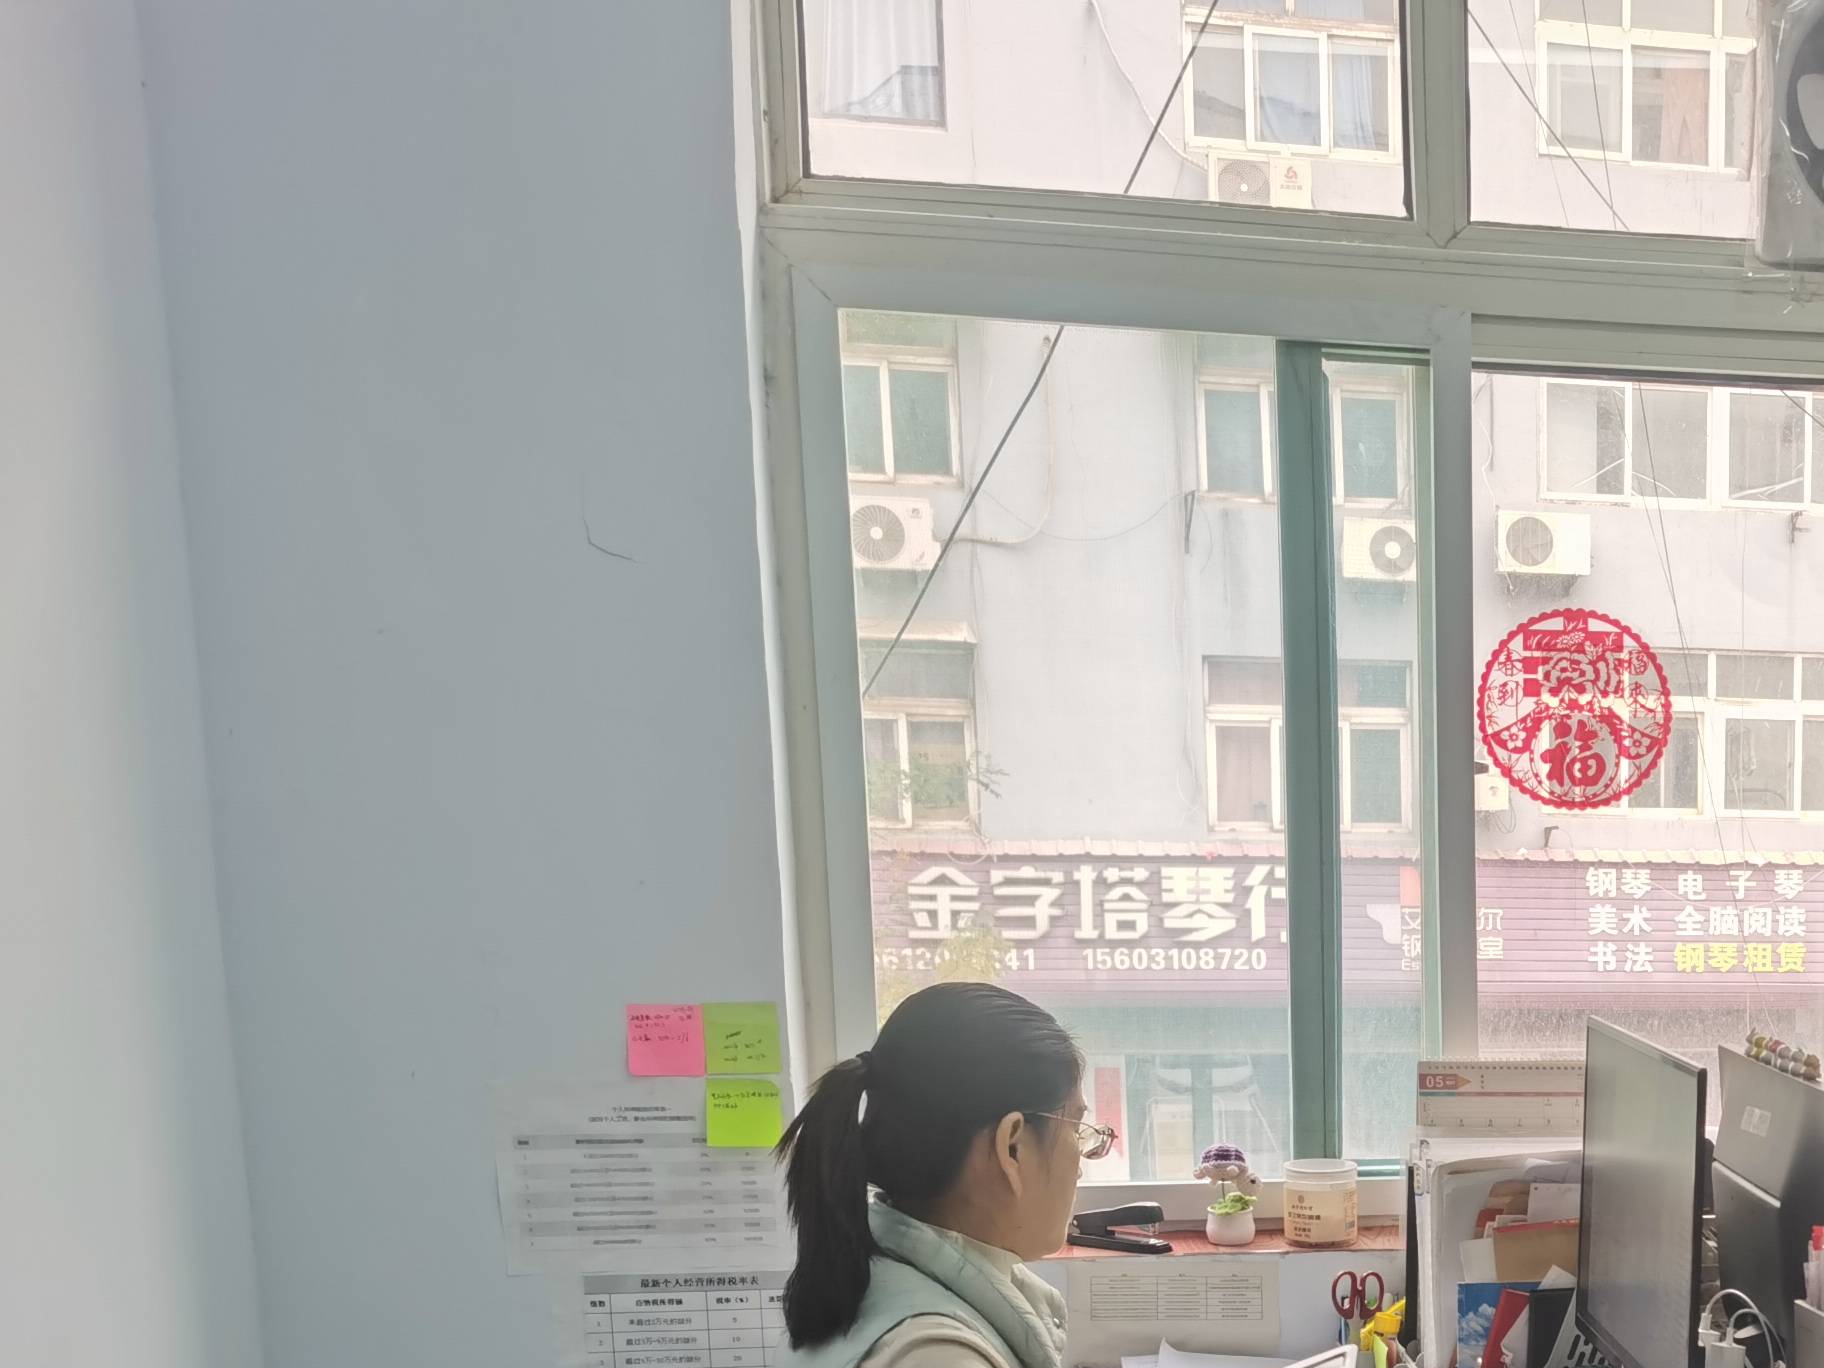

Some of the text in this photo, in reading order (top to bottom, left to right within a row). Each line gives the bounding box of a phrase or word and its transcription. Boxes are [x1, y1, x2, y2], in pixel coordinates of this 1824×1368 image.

[1585, 867, 1652, 900] 钢琴
[1587, 903, 1808, 938] 美术 全脑阅读
[1082, 948, 1268, 970] 15603108720
[1587, 941, 1808, 974] 书法 钢琴租赁
[1425, 1075, 1444, 1088] 05
